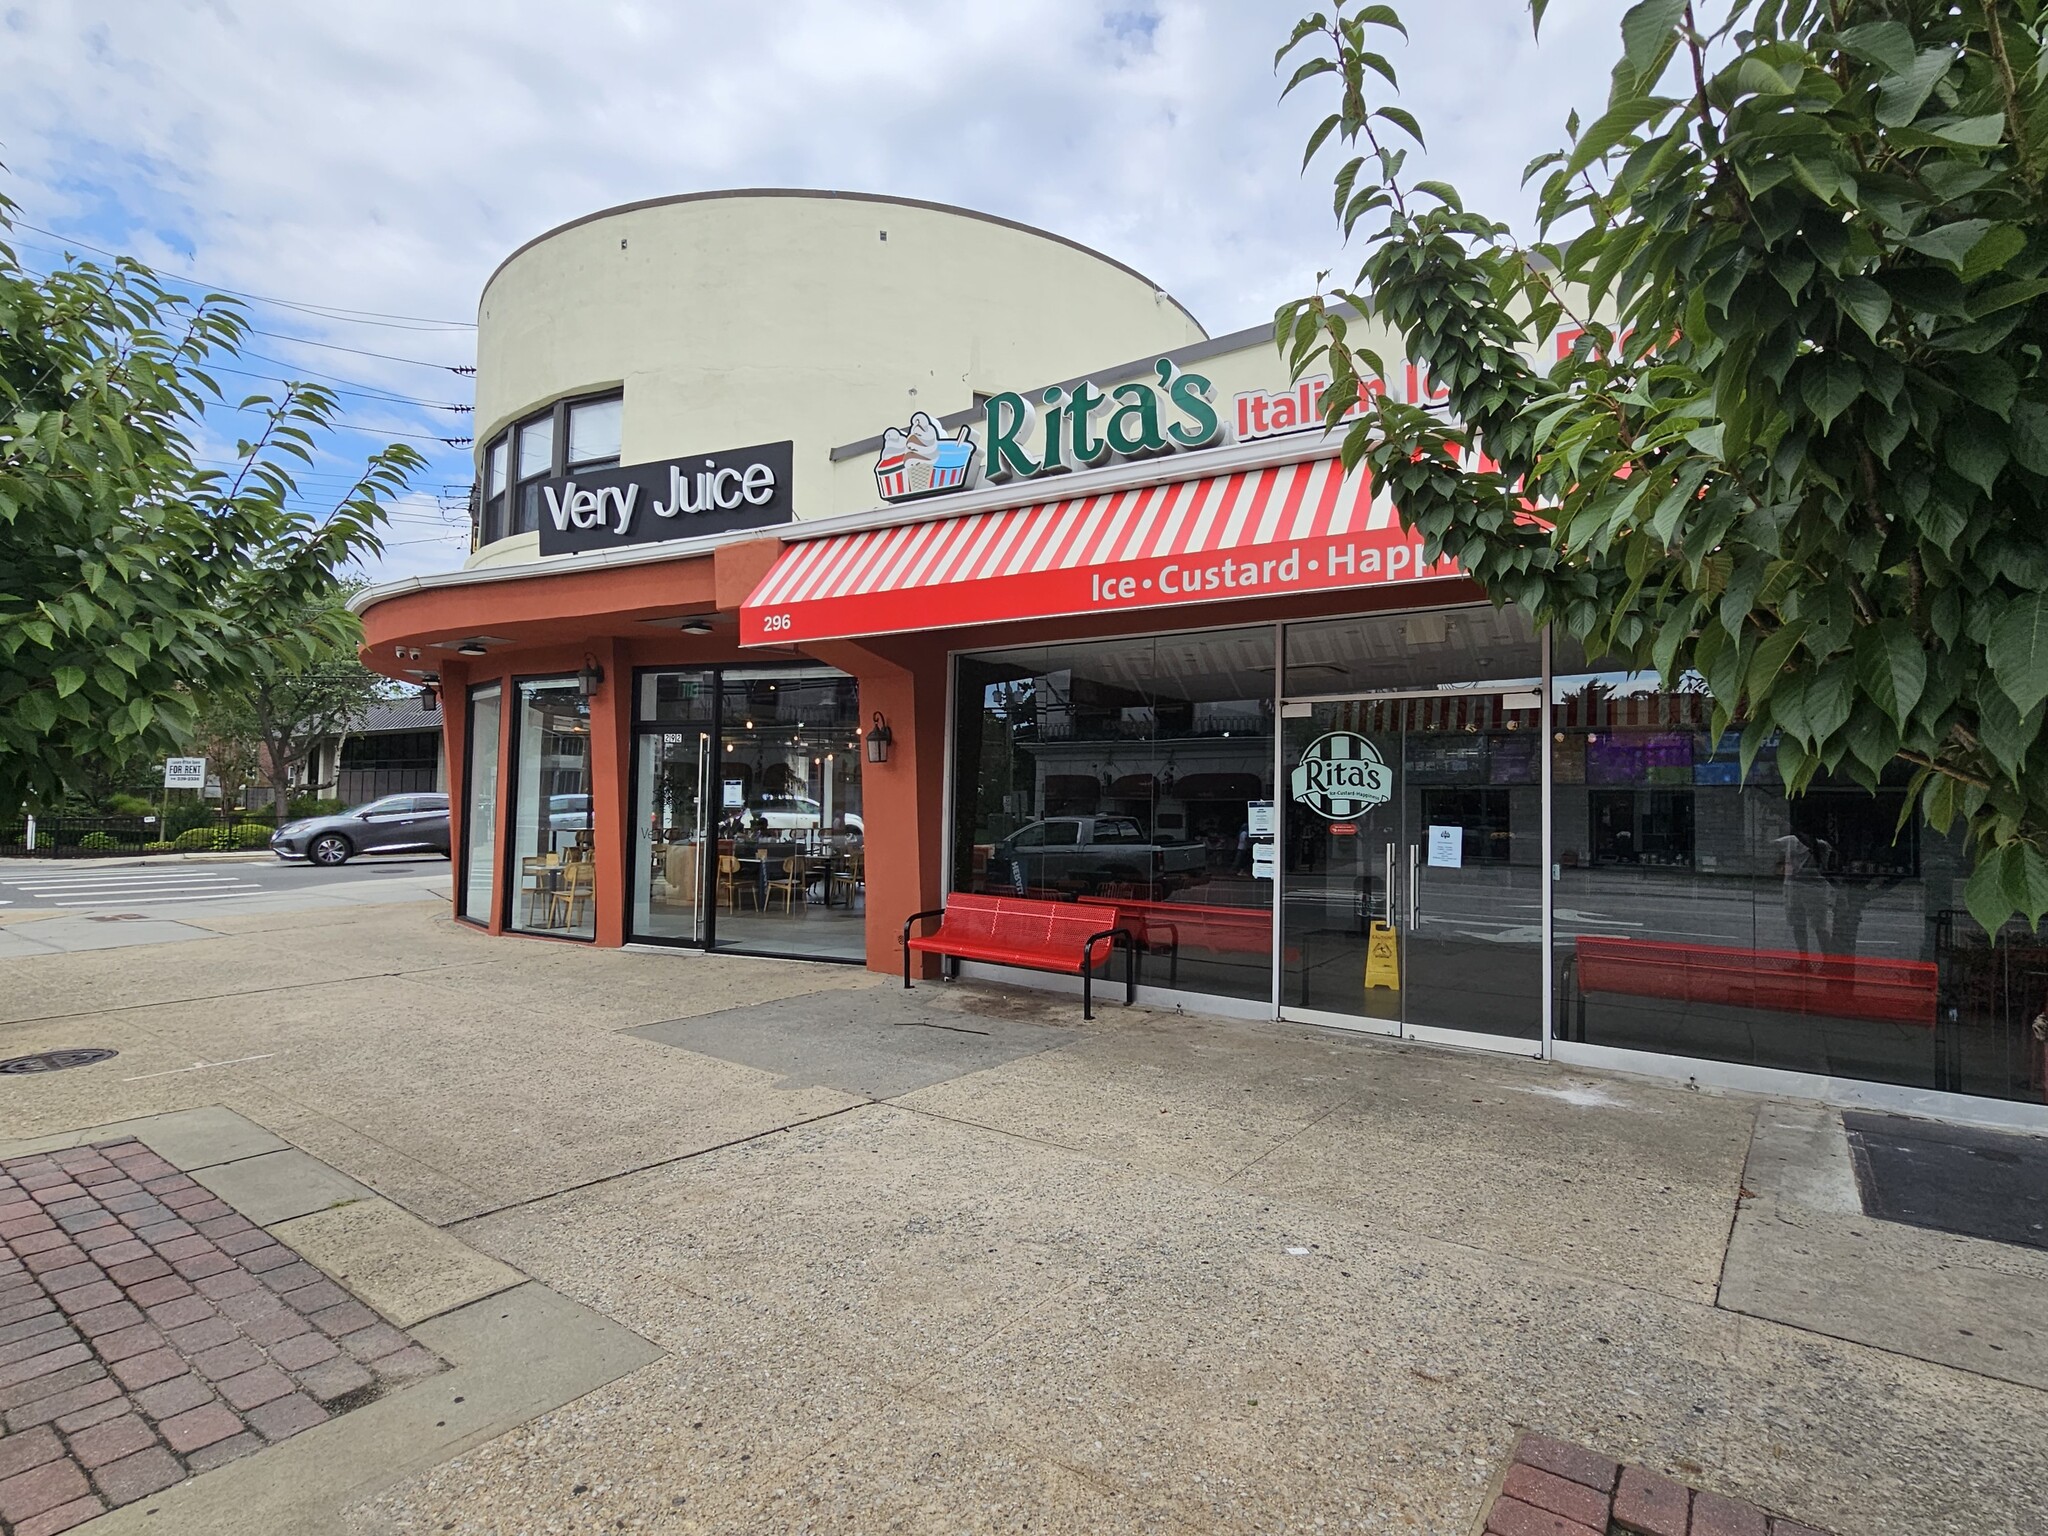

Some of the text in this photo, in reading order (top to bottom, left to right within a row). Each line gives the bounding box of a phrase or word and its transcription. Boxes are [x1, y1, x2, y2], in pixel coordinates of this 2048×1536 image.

[984, 357, 1218, 480] Rita's
[1237, 377, 1387, 436] Italin
[543, 459, 775, 535] Very Juice
[1092, 574, 1136, 601] Ice
[1158, 548, 1299, 594] Custard
[763, 614, 791, 632] 296
[664, 734, 682, 743] 292
[169, 765, 201, 774] FOR RENT
[1305, 759, 1381, 792] Rita's
